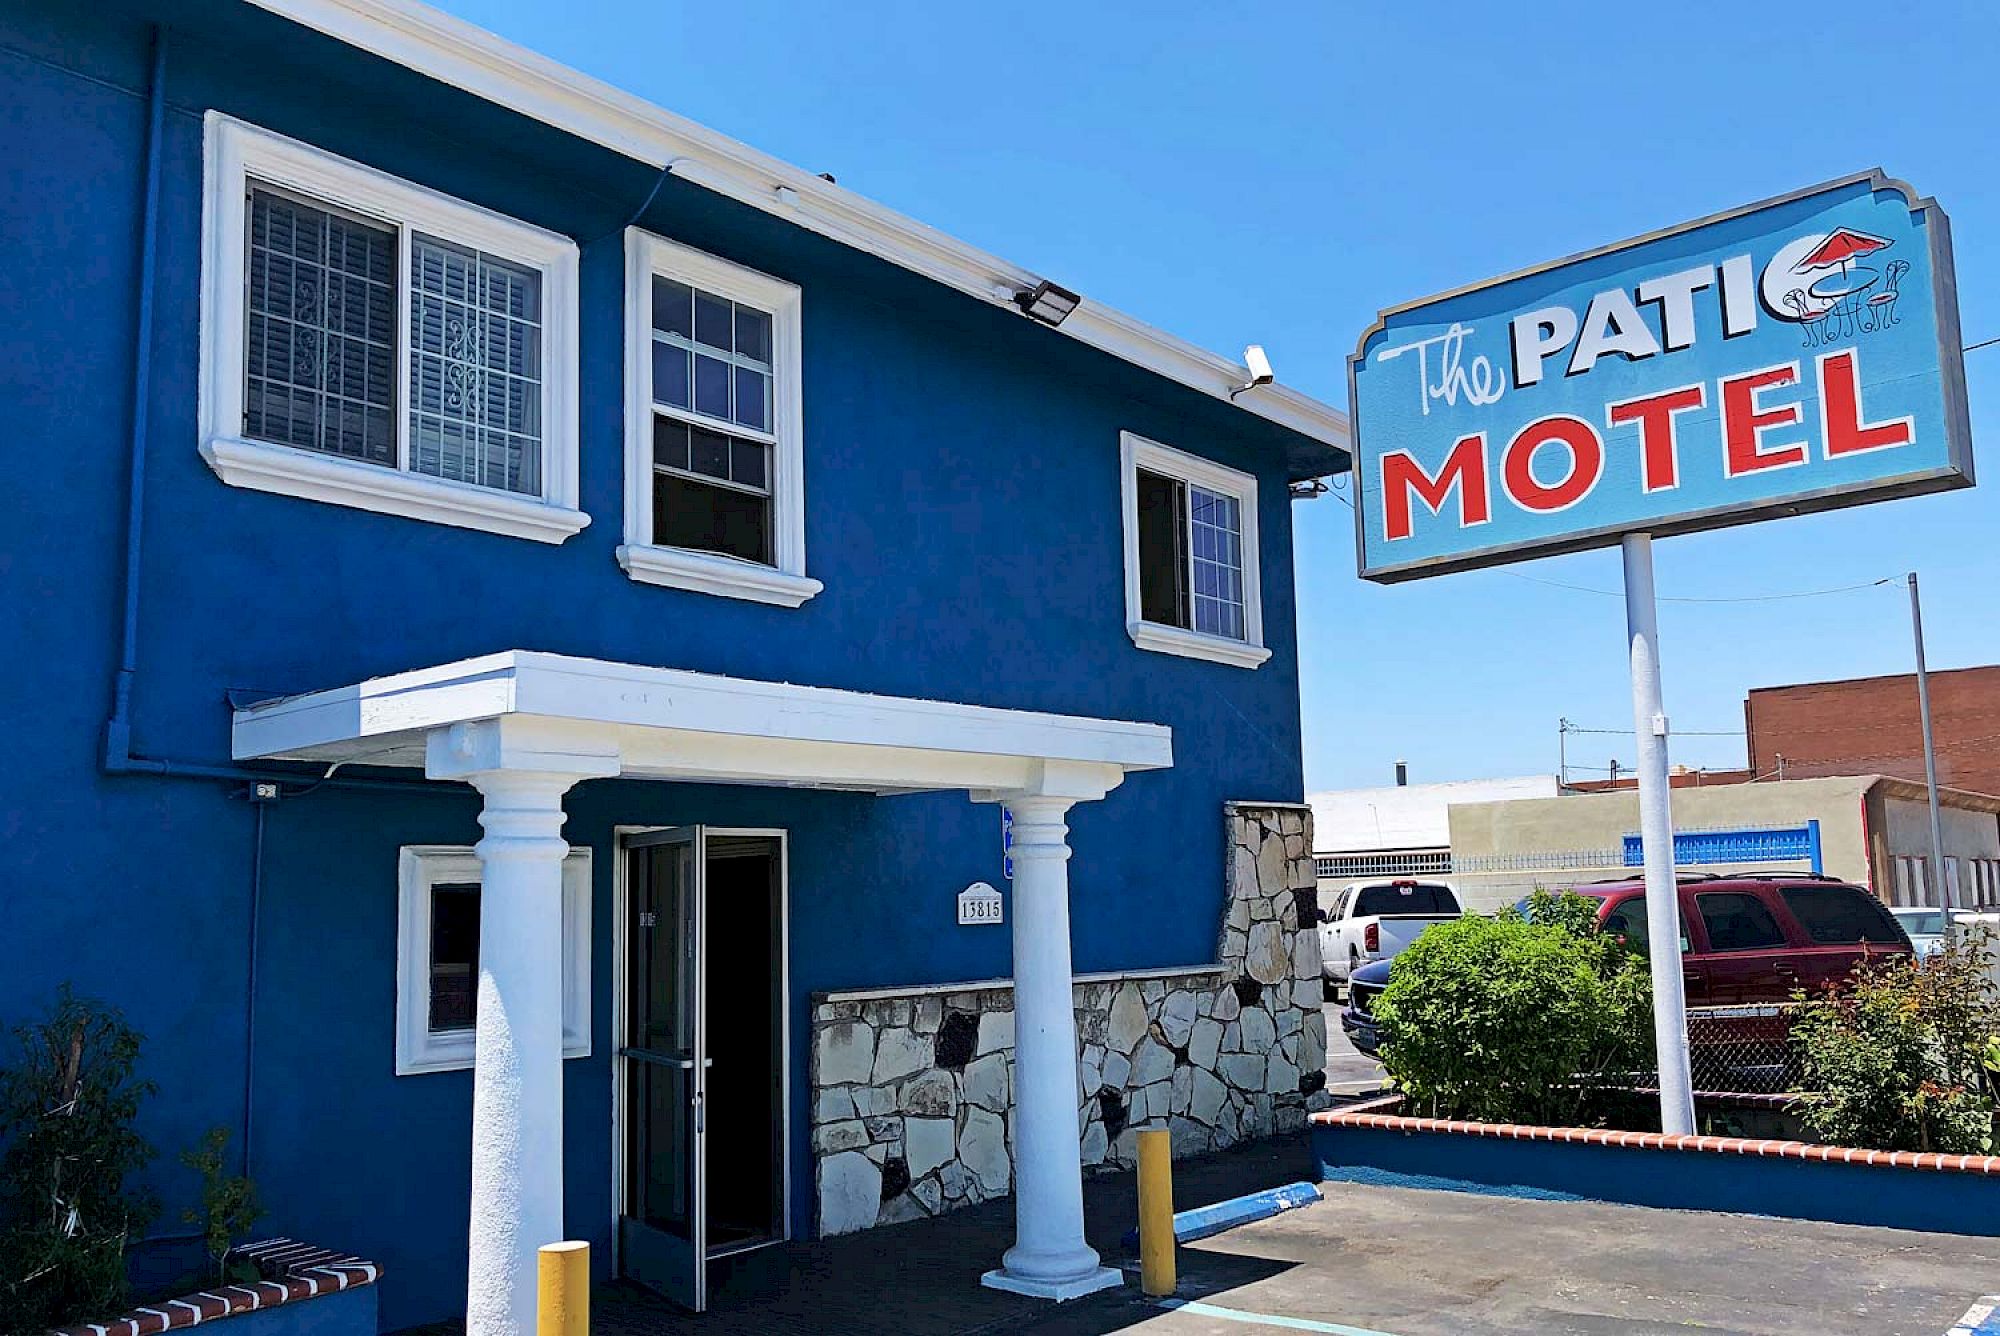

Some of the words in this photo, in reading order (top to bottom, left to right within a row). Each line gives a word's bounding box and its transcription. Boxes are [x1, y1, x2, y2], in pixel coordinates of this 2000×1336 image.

[1377, 322, 1506, 415] The
[1510, 234, 1857, 388] PATIO
[1379, 347, 1915, 542] MOTEL
[963, 901, 1000, 918] 13815
